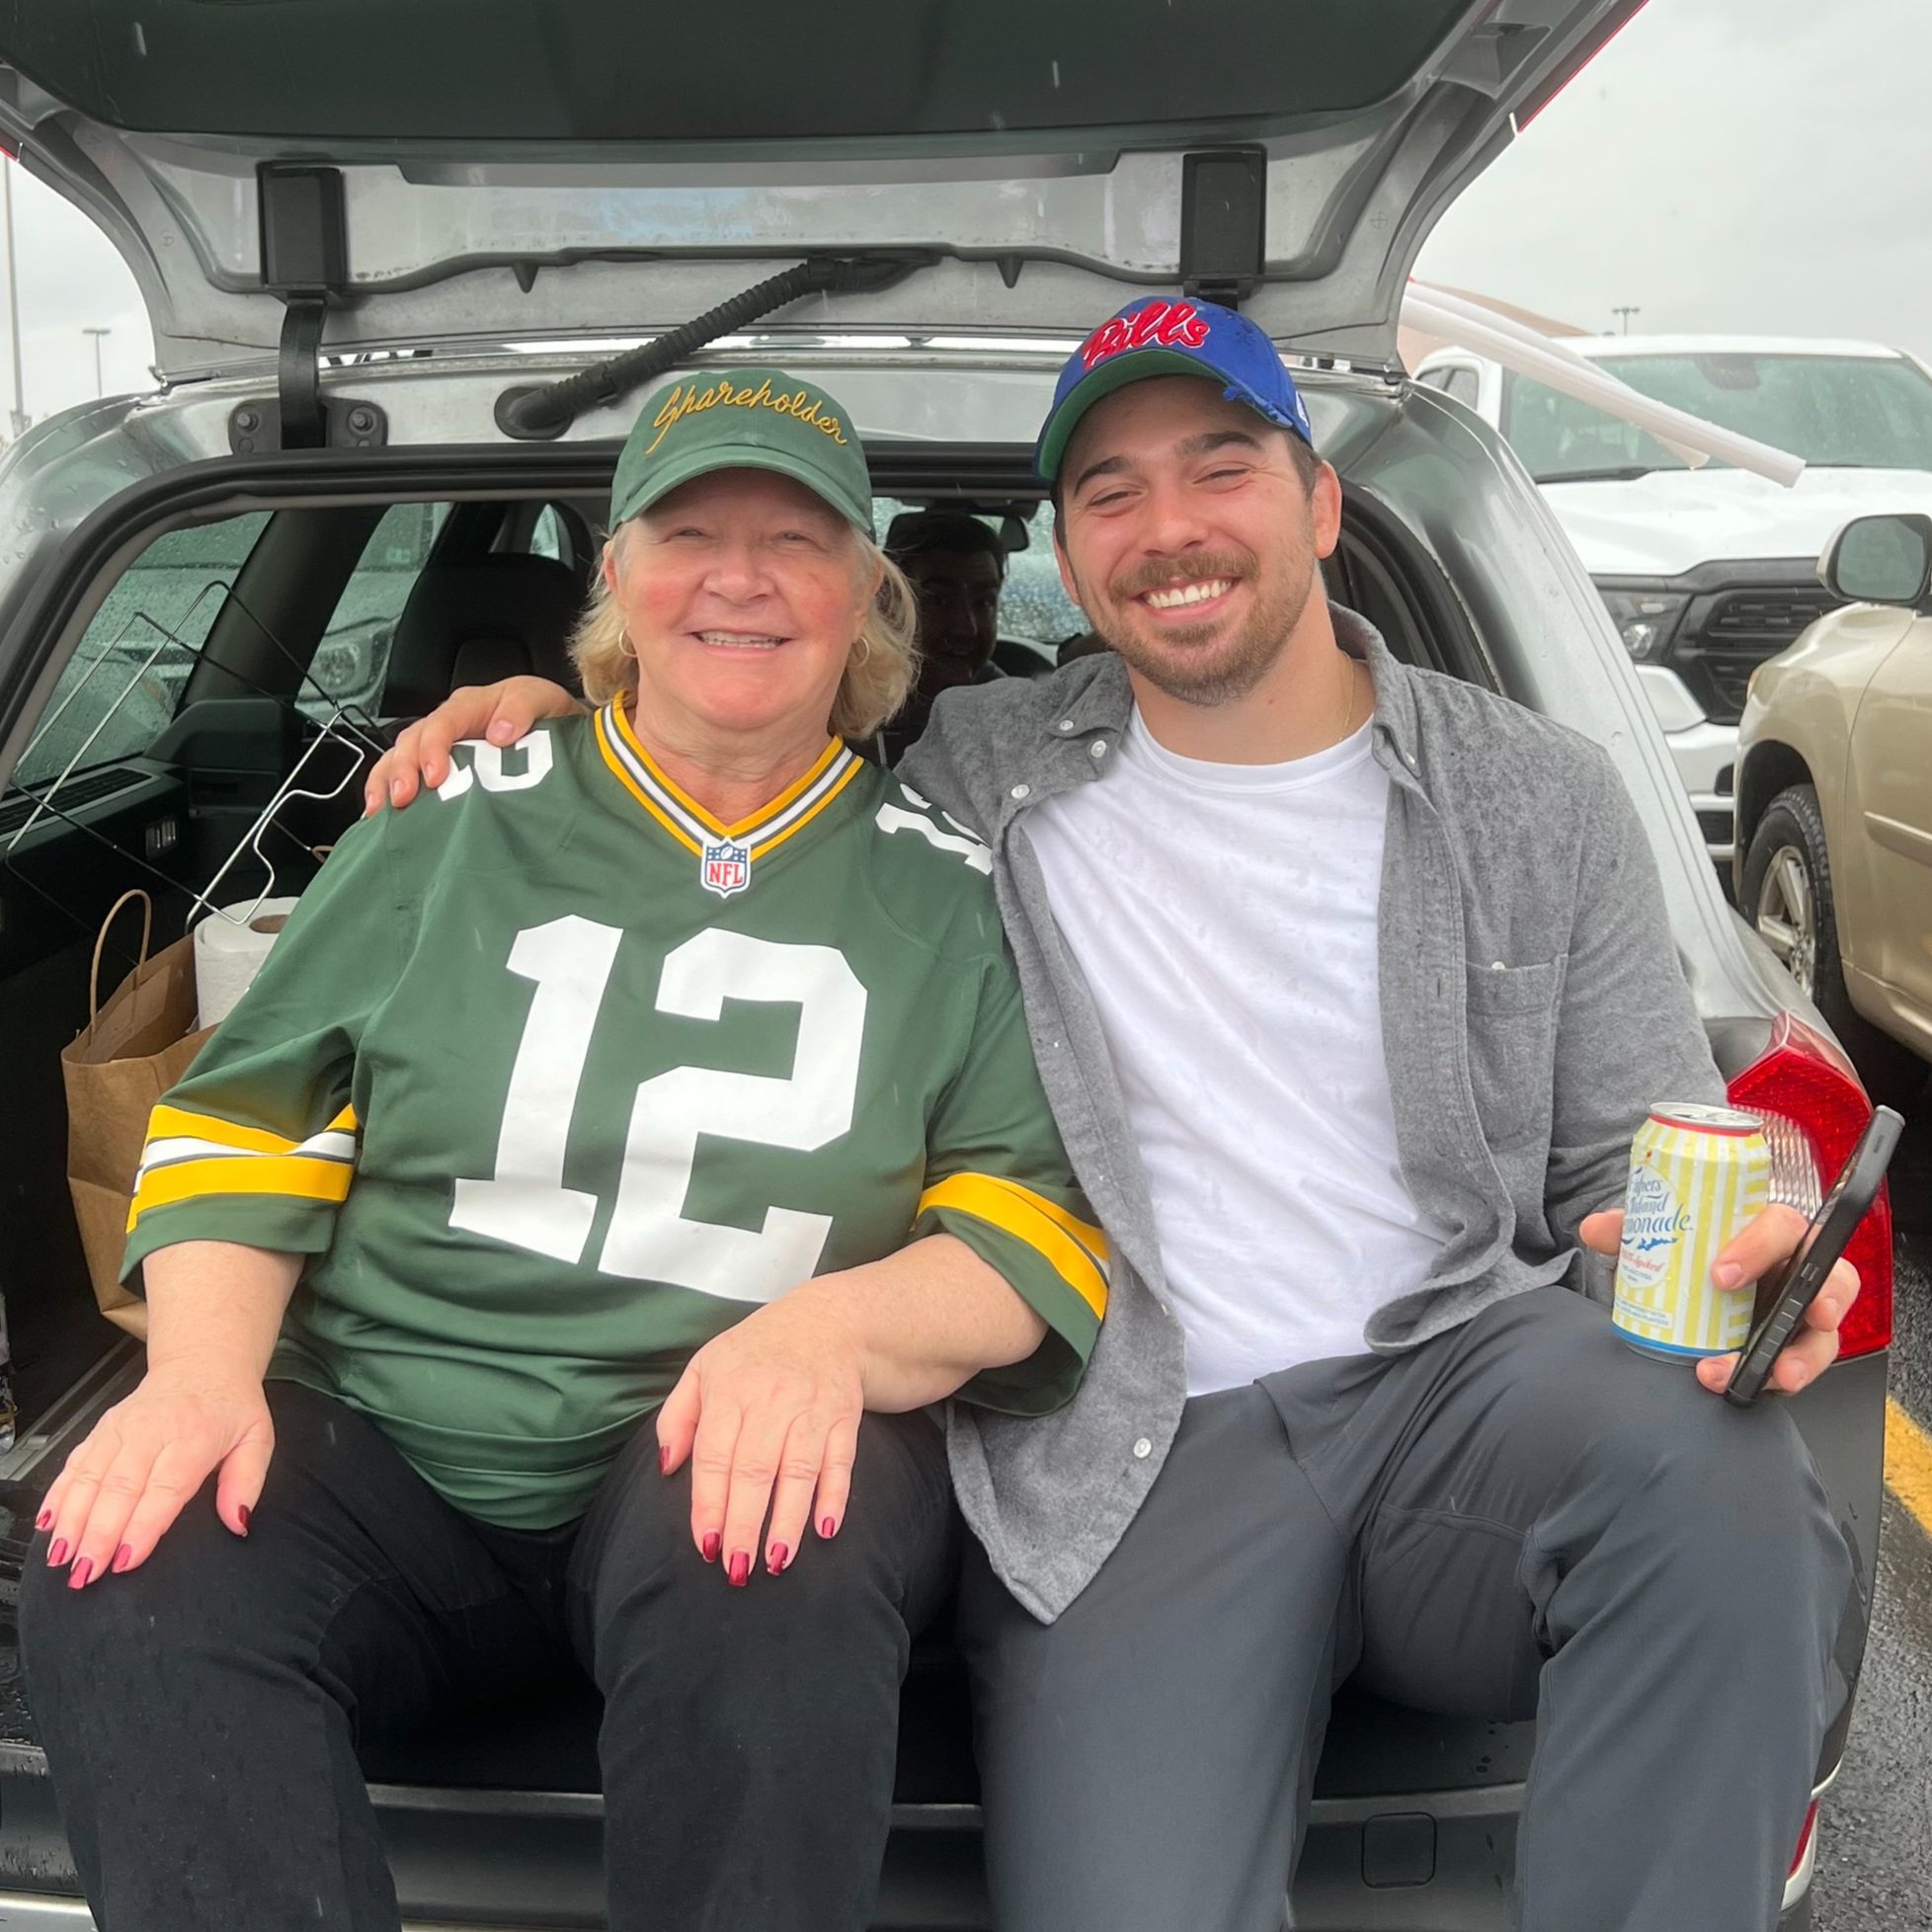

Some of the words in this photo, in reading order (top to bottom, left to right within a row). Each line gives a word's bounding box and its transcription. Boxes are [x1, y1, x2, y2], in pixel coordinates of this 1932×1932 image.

[1081, 300, 1211, 371] Bills
[645, 377, 847, 455] Shareholder
[708, 861, 744, 887] NFL
[447, 914, 869, 1304] 12
